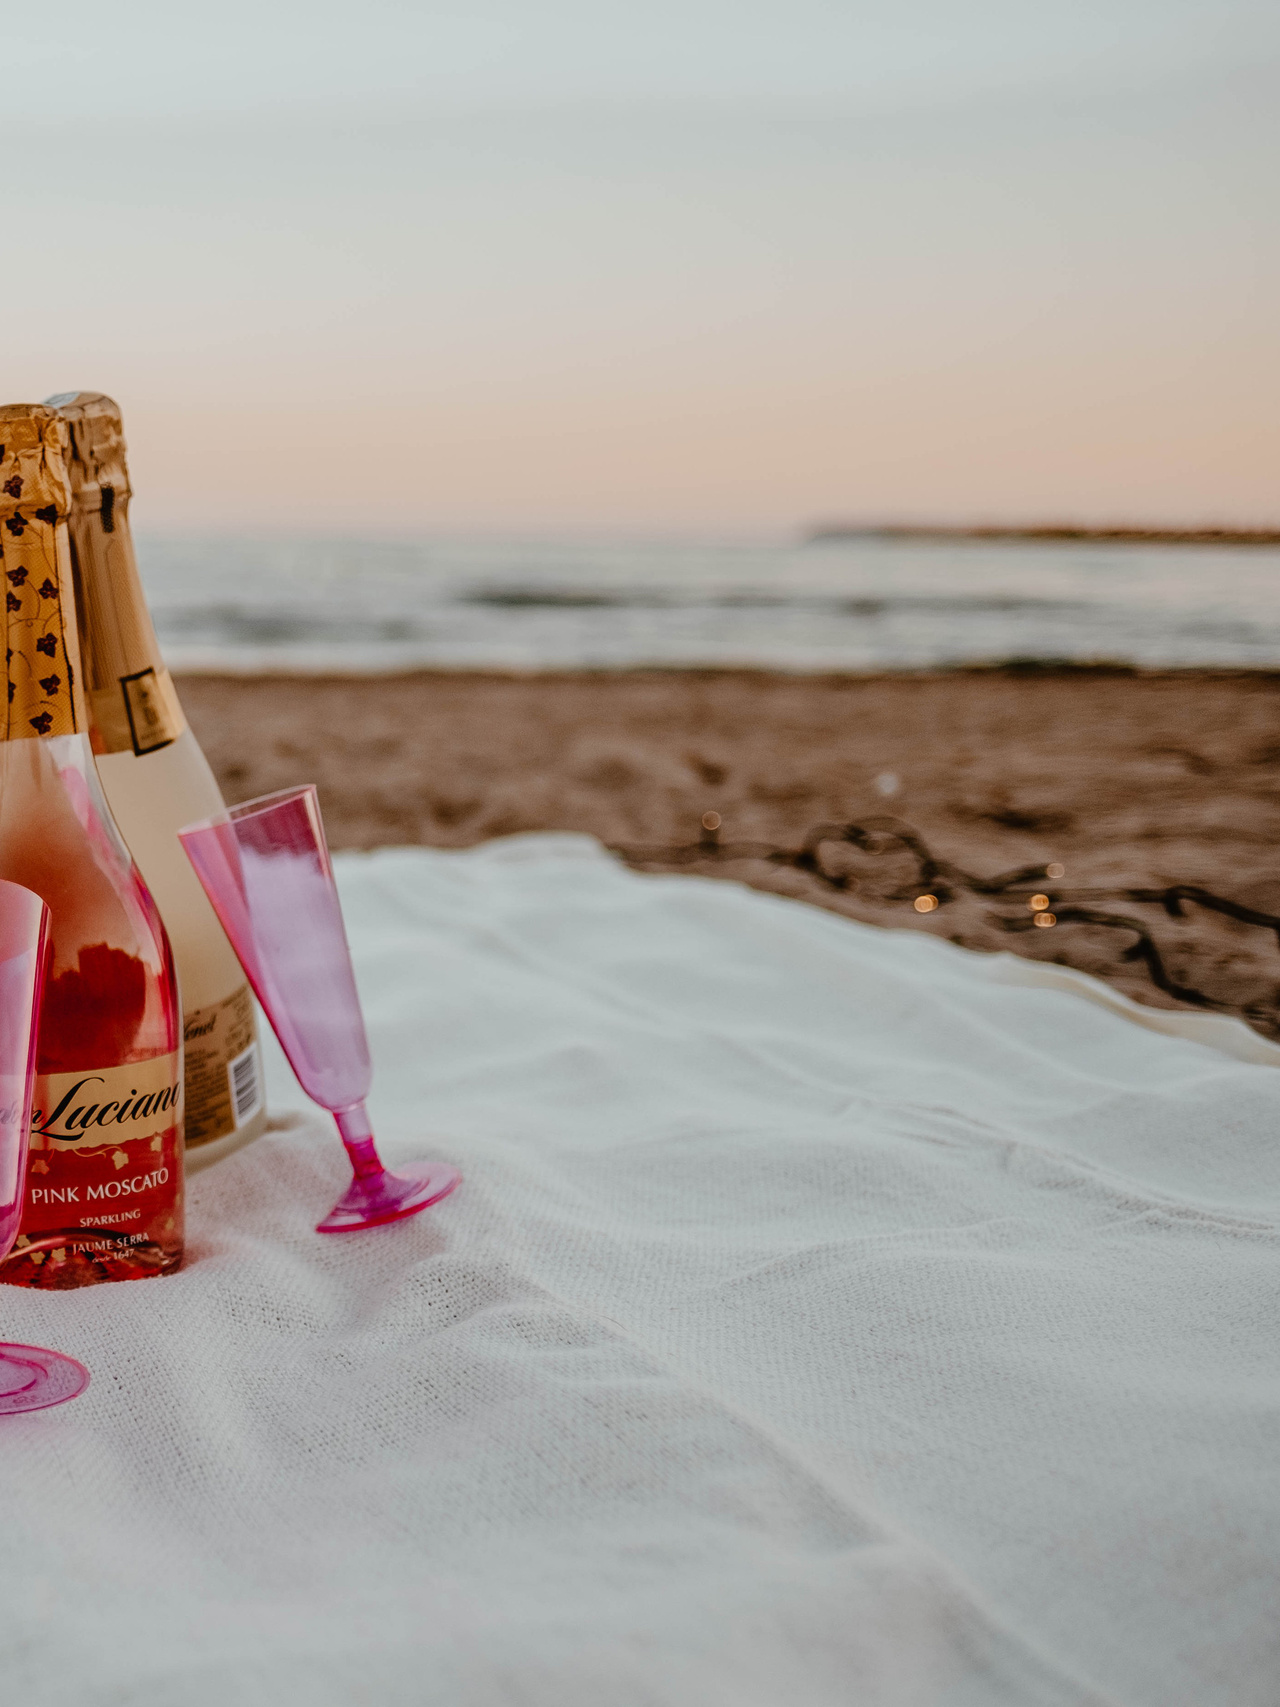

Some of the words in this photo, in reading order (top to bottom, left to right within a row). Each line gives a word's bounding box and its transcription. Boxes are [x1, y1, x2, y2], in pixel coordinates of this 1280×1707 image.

[31, 1187, 79, 1204] PINK
[86, 1167, 169, 1201] MOSCATO
[80, 1208, 141, 1228] SPARKLING
[72, 1239, 114, 1255] JAUME
[116, 1232, 150, 1248] SERRA
[112, 1248, 135, 1260] 1647
